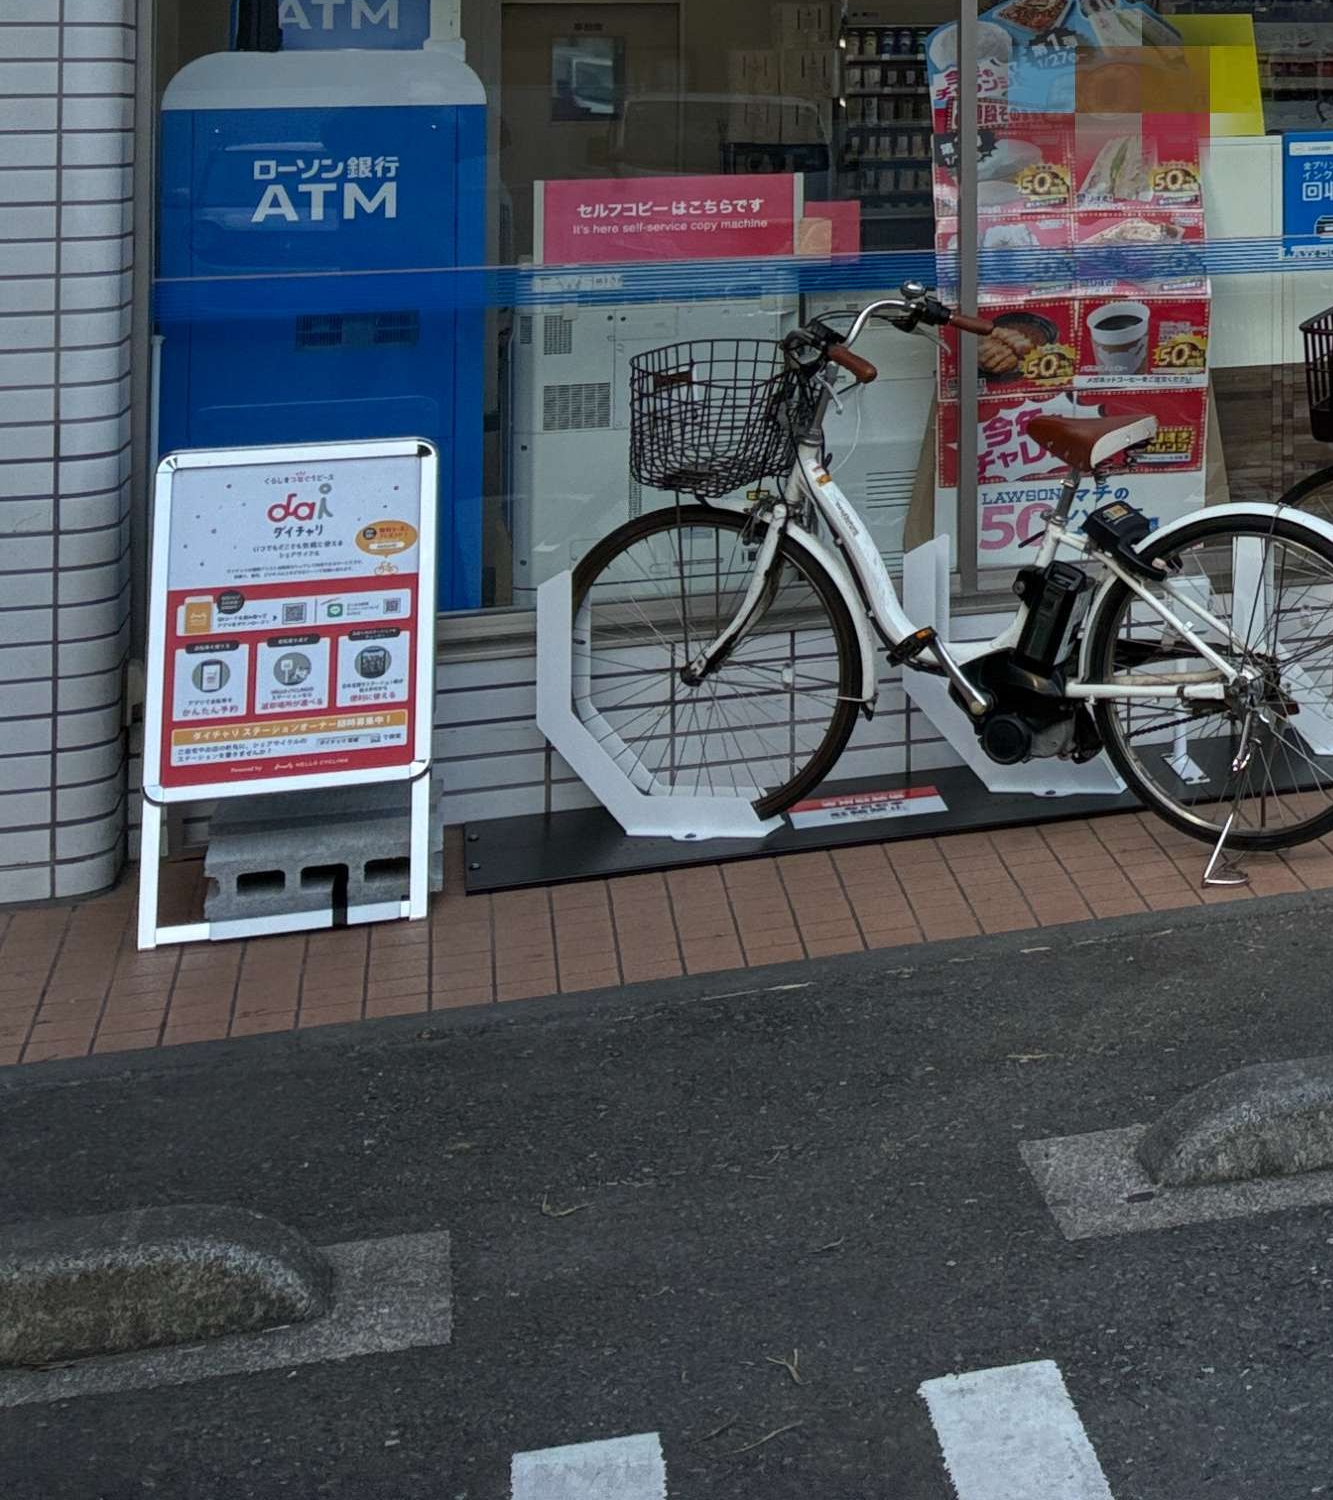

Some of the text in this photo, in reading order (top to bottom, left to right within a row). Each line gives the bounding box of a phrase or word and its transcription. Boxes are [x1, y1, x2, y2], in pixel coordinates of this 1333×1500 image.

[253, 156, 400, 182] ローソン銀行
[251, 181, 398, 223] ATM
[593, 224, 619, 234] here
[622, 221, 688, 234] self-service
[690, 220, 717, 232] copy
[720, 218, 768, 230] machine
[266, 482, 334, 523] dai
[981, 487, 1063, 506] LAWSON
